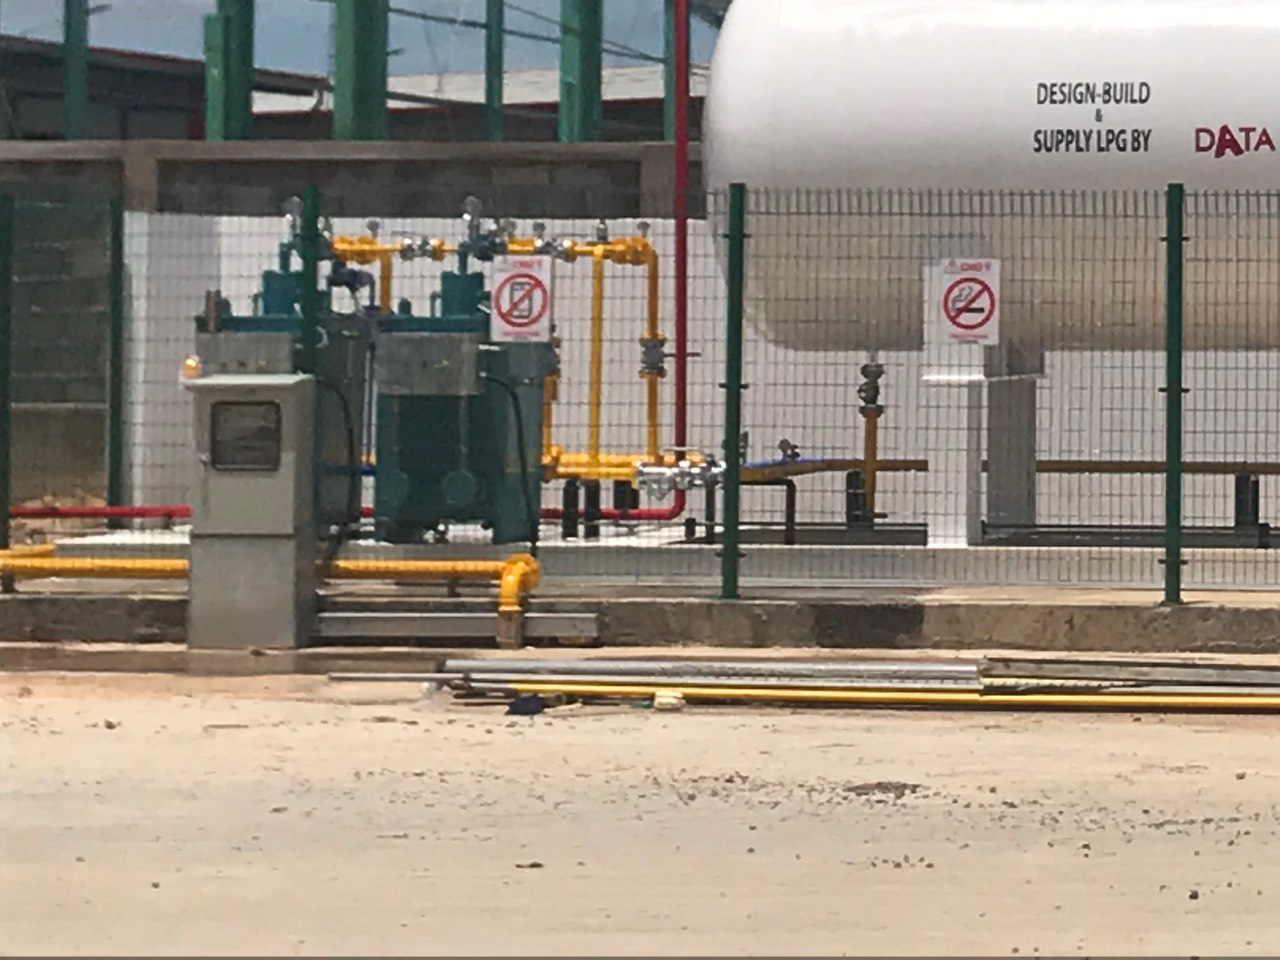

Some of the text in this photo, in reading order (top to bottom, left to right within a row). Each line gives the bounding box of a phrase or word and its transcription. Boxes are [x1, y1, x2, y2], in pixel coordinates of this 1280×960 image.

[1037, 82, 1150, 104] DESIGN-BUILD
[1095, 108, 1103, 122] &
[1034, 128, 1152, 153] SUPPLY LPG BY
[1195, 125, 1276, 158] DATA
